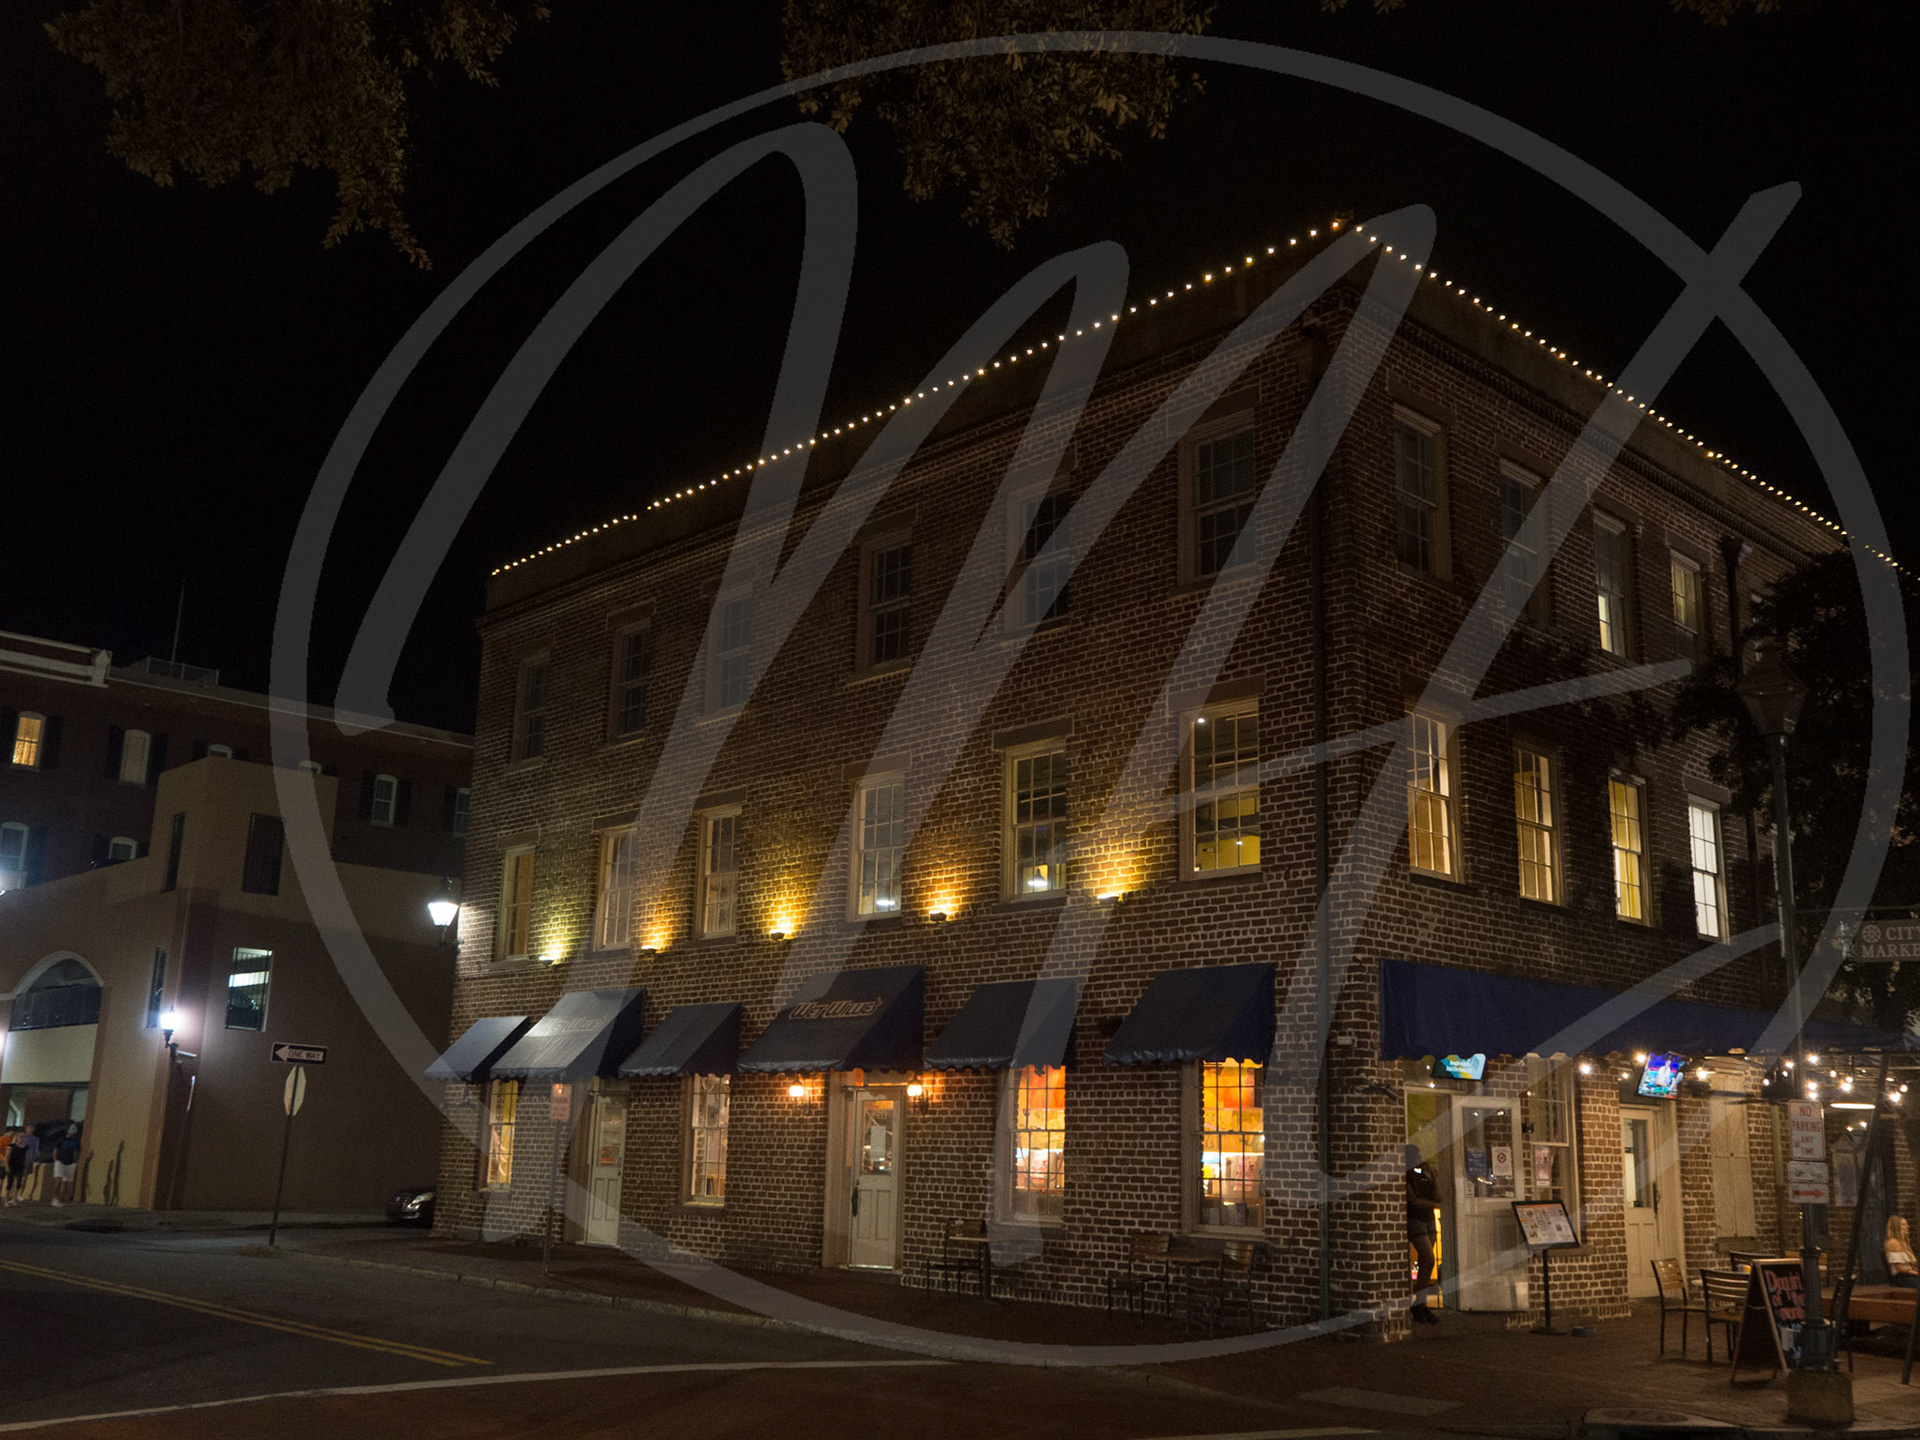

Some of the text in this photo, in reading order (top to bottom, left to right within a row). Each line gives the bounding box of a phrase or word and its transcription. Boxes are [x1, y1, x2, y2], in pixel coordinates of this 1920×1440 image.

[1885, 925, 1920, 941] CIT
[1861, 943, 1920, 958] MARKE
[288, 1050, 322, 1060] ONE WAY
[1800, 1106, 1811, 1117] NO
[1792, 1120, 1821, 1132] PARKING
[1801, 1135, 1813, 1143] ANY
